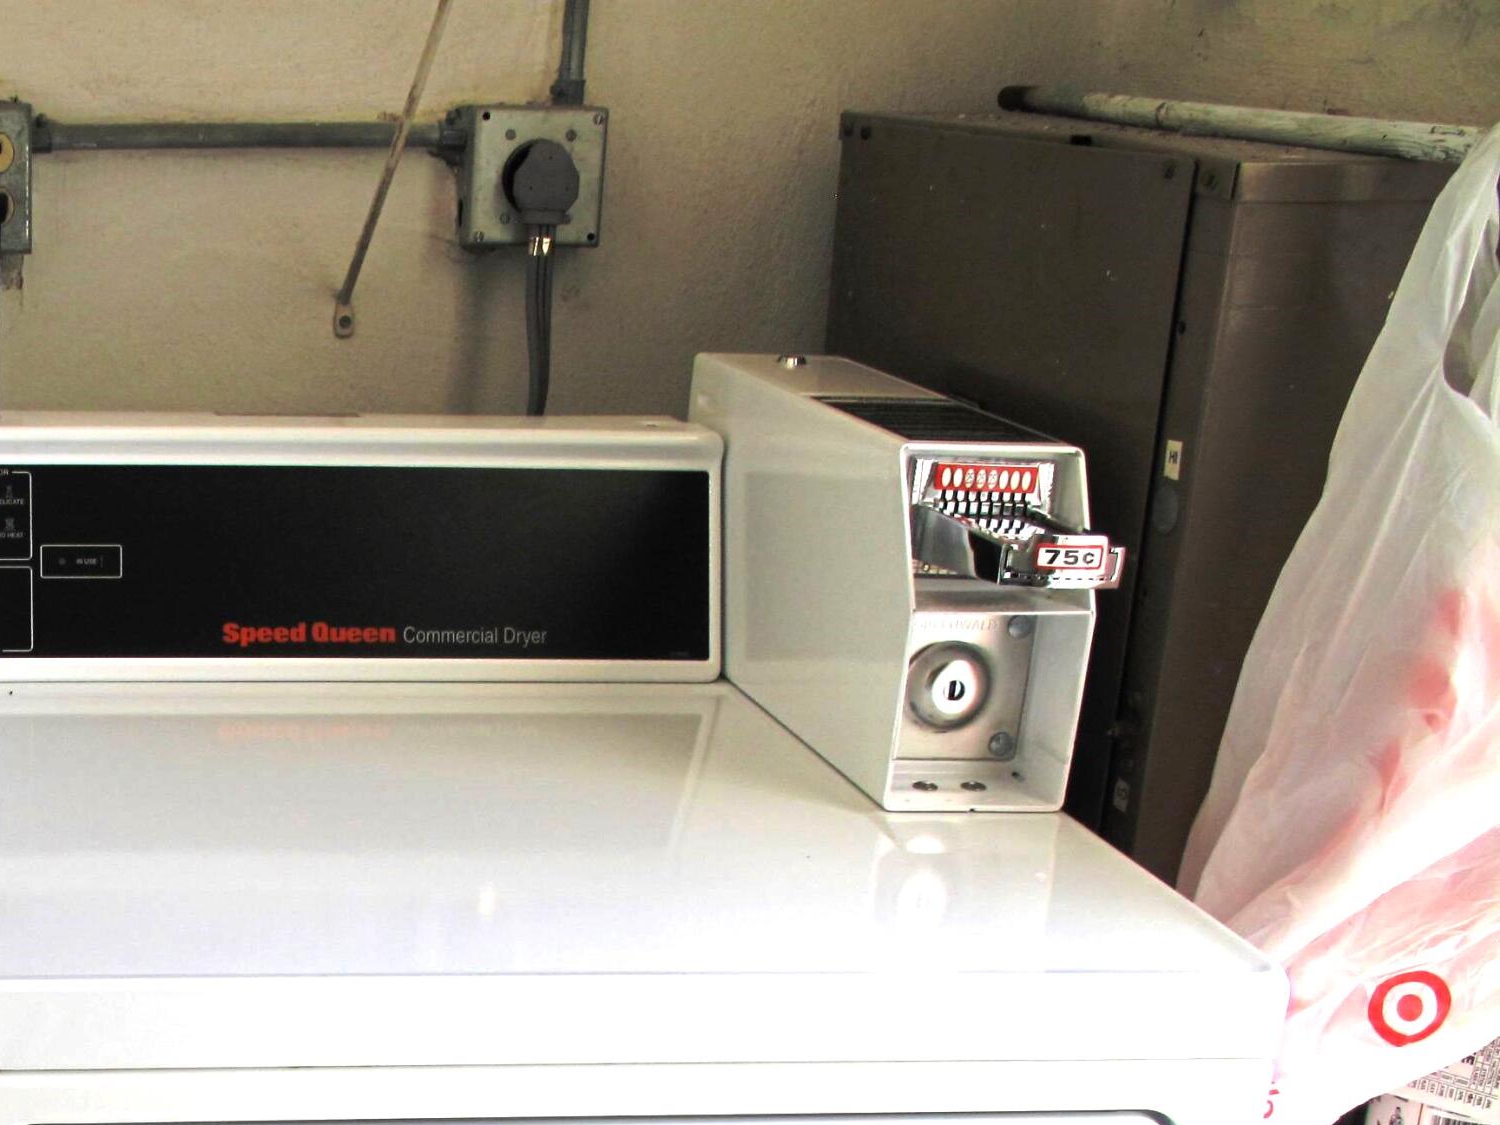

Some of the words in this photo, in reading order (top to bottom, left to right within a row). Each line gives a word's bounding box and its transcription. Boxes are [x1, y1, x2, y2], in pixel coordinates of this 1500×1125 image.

[1044, 549, 1095, 566] 75¢
[222, 622, 306, 647] Speed
[311, 622, 396, 644] Queen
[403, 626, 498, 644] Commercial
[503, 627, 548, 648] Dryer
